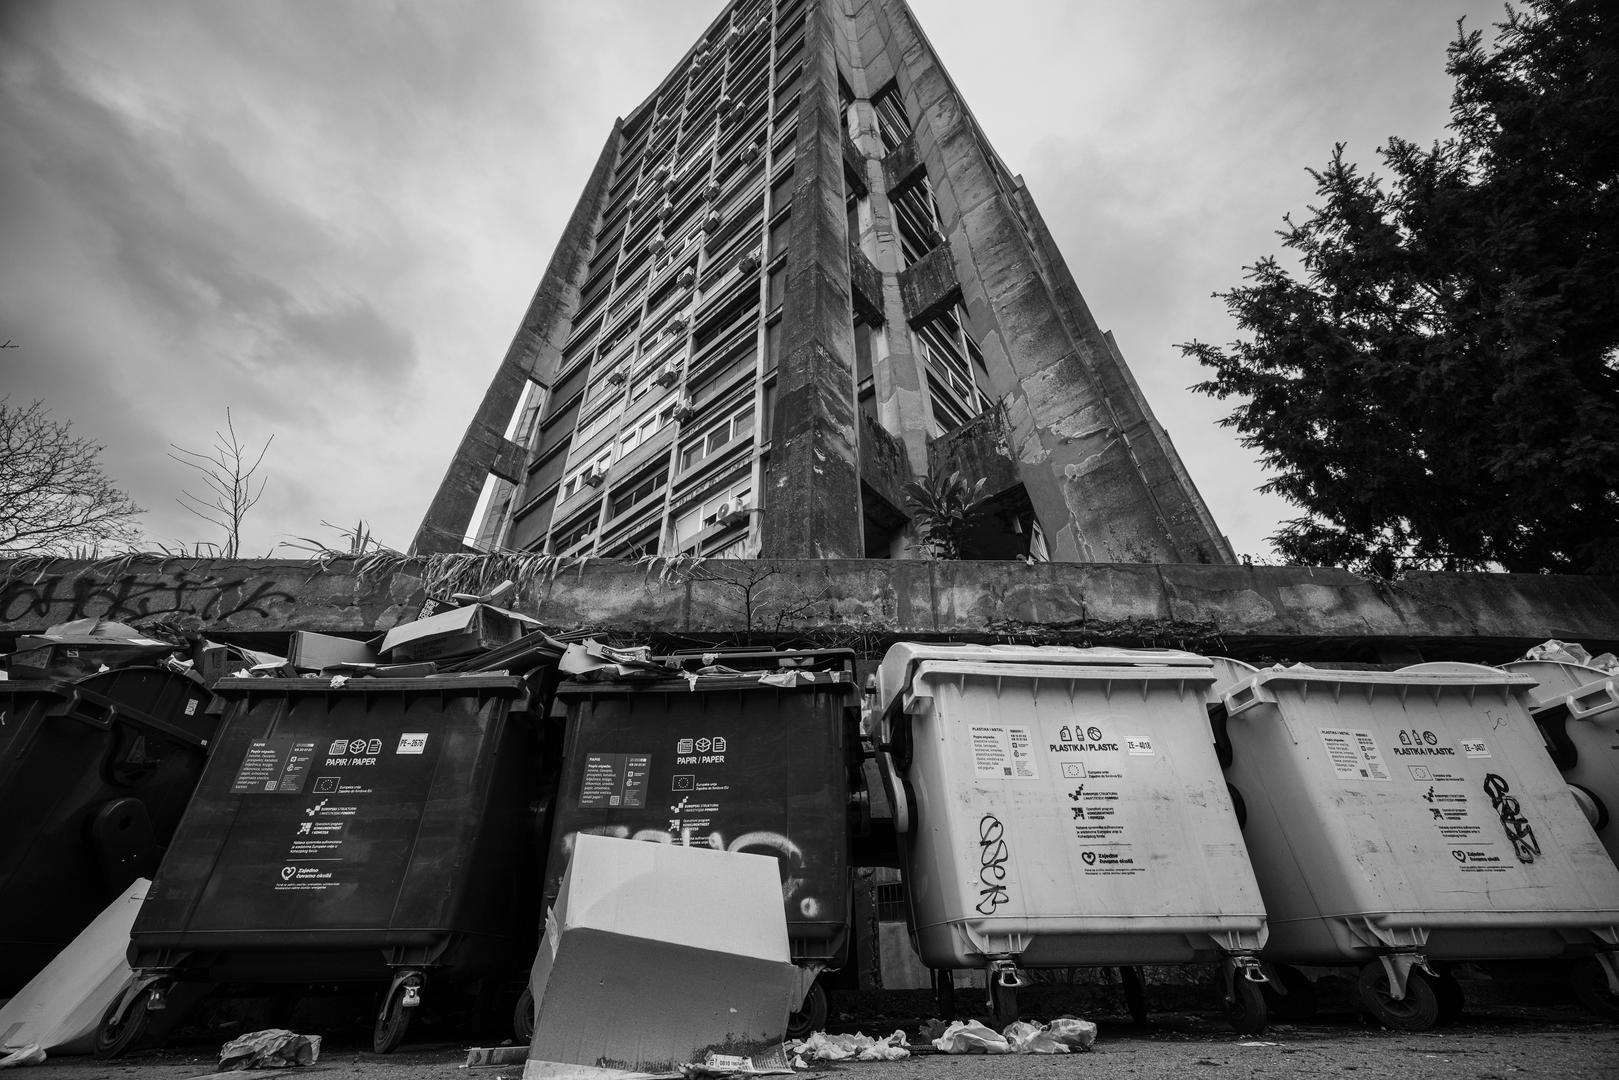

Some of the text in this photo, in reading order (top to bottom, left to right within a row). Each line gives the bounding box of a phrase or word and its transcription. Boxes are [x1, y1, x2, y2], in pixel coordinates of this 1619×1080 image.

[1049, 743, 1086, 752] PLASTIKA
[1089, 743, 1119, 752] PLASTIC
[1393, 747, 1425, 756] PLASTIKA
[1427, 747, 1455, 756] PLASTIC
[325, 758, 347, 766] PAPIR
[352, 757, 377, 766] PAPER
[676, 756, 697, 765] PAPIR
[702, 755, 725, 764] PAPER
